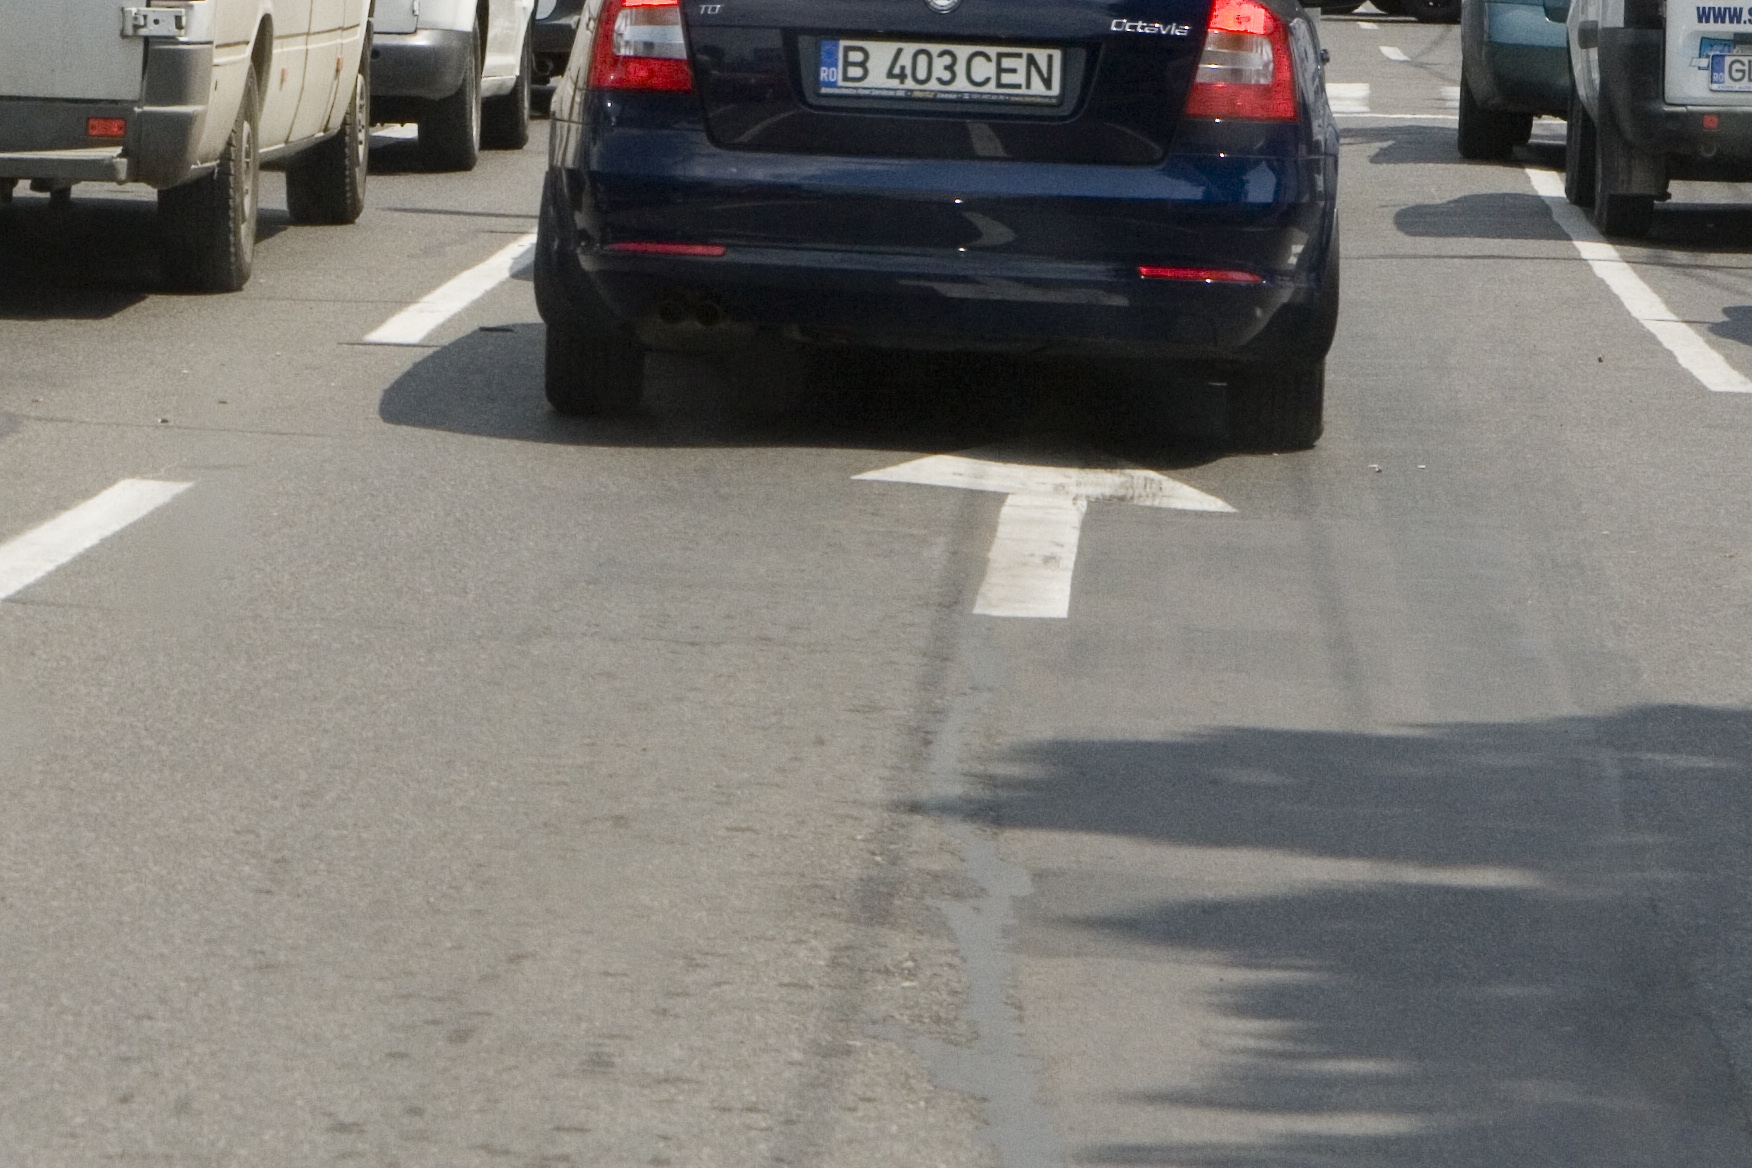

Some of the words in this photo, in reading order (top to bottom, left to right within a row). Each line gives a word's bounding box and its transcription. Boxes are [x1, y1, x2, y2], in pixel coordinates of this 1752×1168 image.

[1110, 18, 1193, 36] Octavia
[842, 46, 869, 78] B
[821, 67, 837, 82] RO
[1713, 73, 1724, 82] RO
